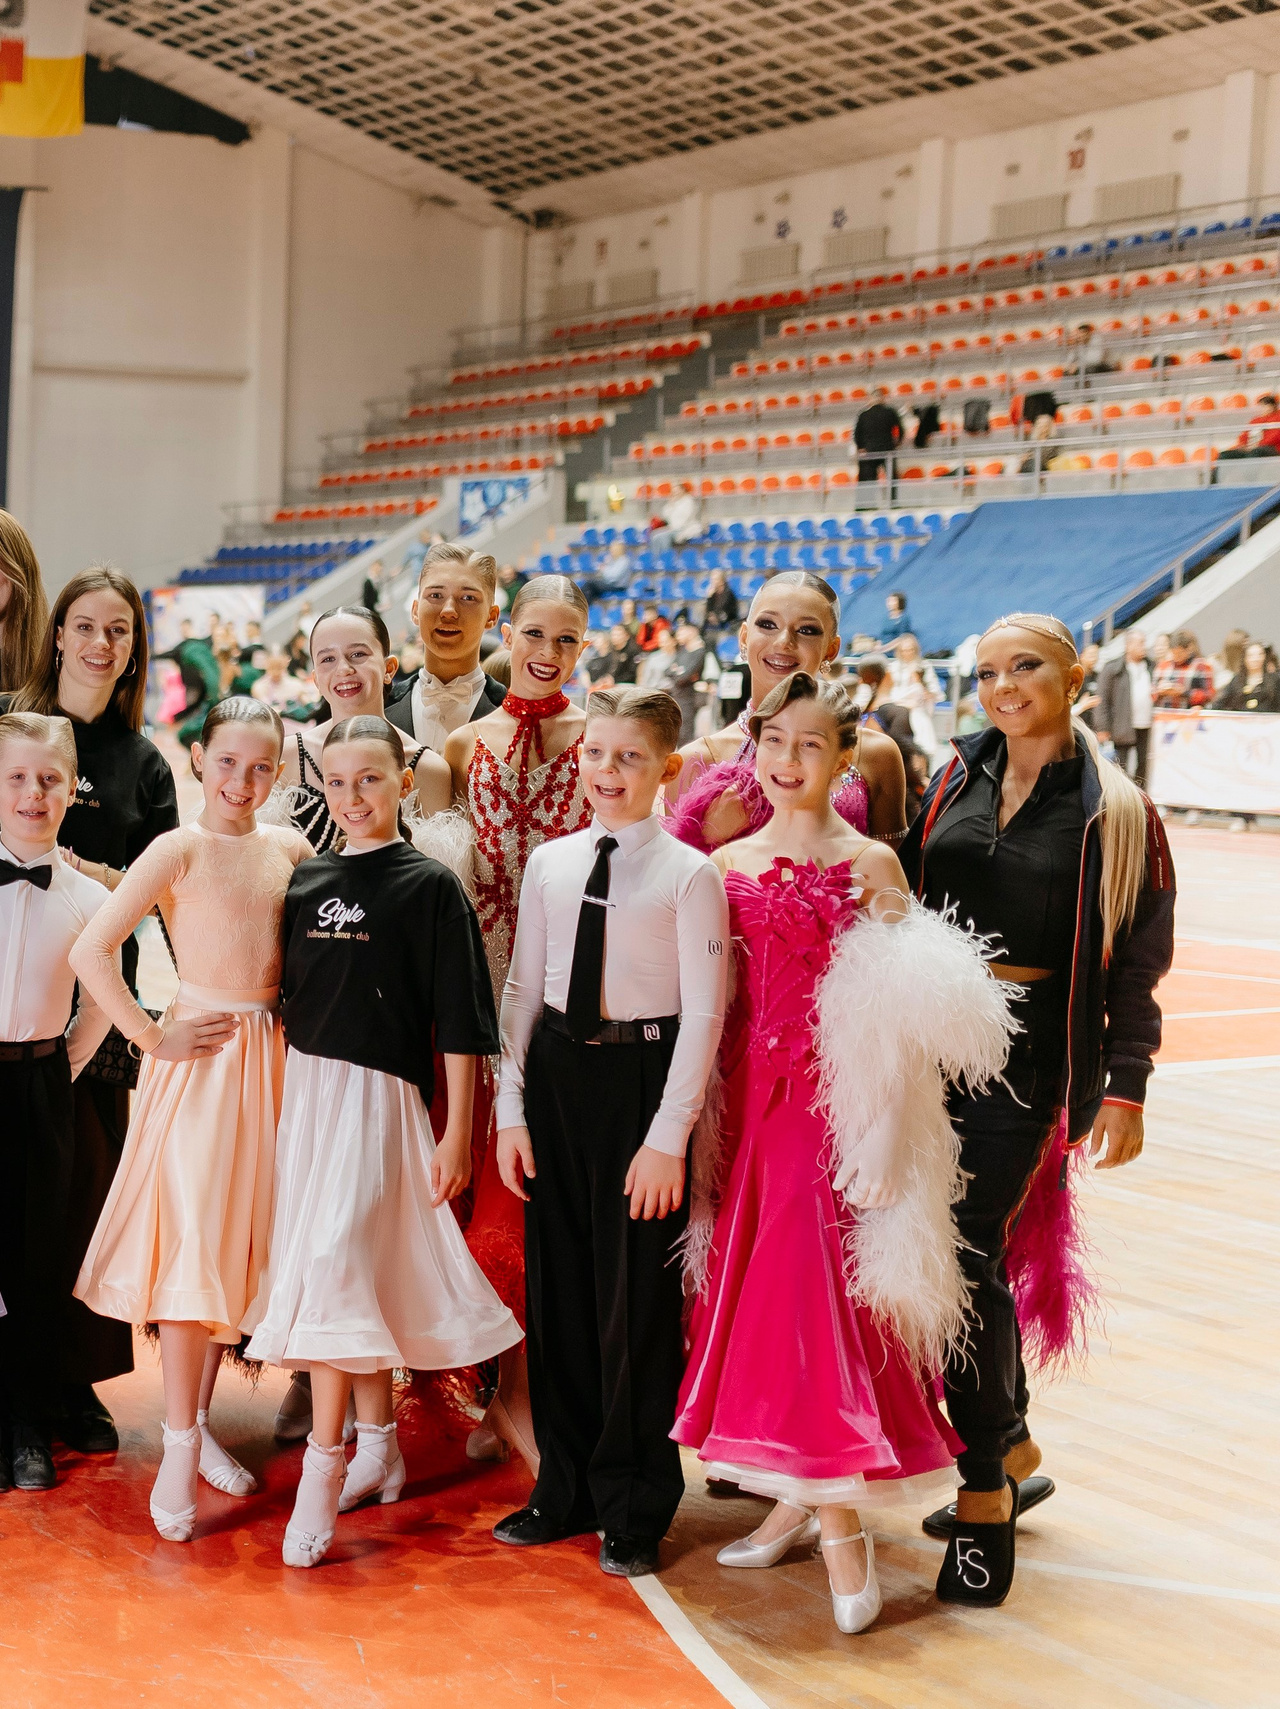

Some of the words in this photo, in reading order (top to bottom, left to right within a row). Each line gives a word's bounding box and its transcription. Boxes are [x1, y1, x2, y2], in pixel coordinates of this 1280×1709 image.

[317, 898, 366, 931] Style
[306, 929, 330, 938] ballroom
[334, 929, 351, 939] dance
[356, 931, 370, 941] club
